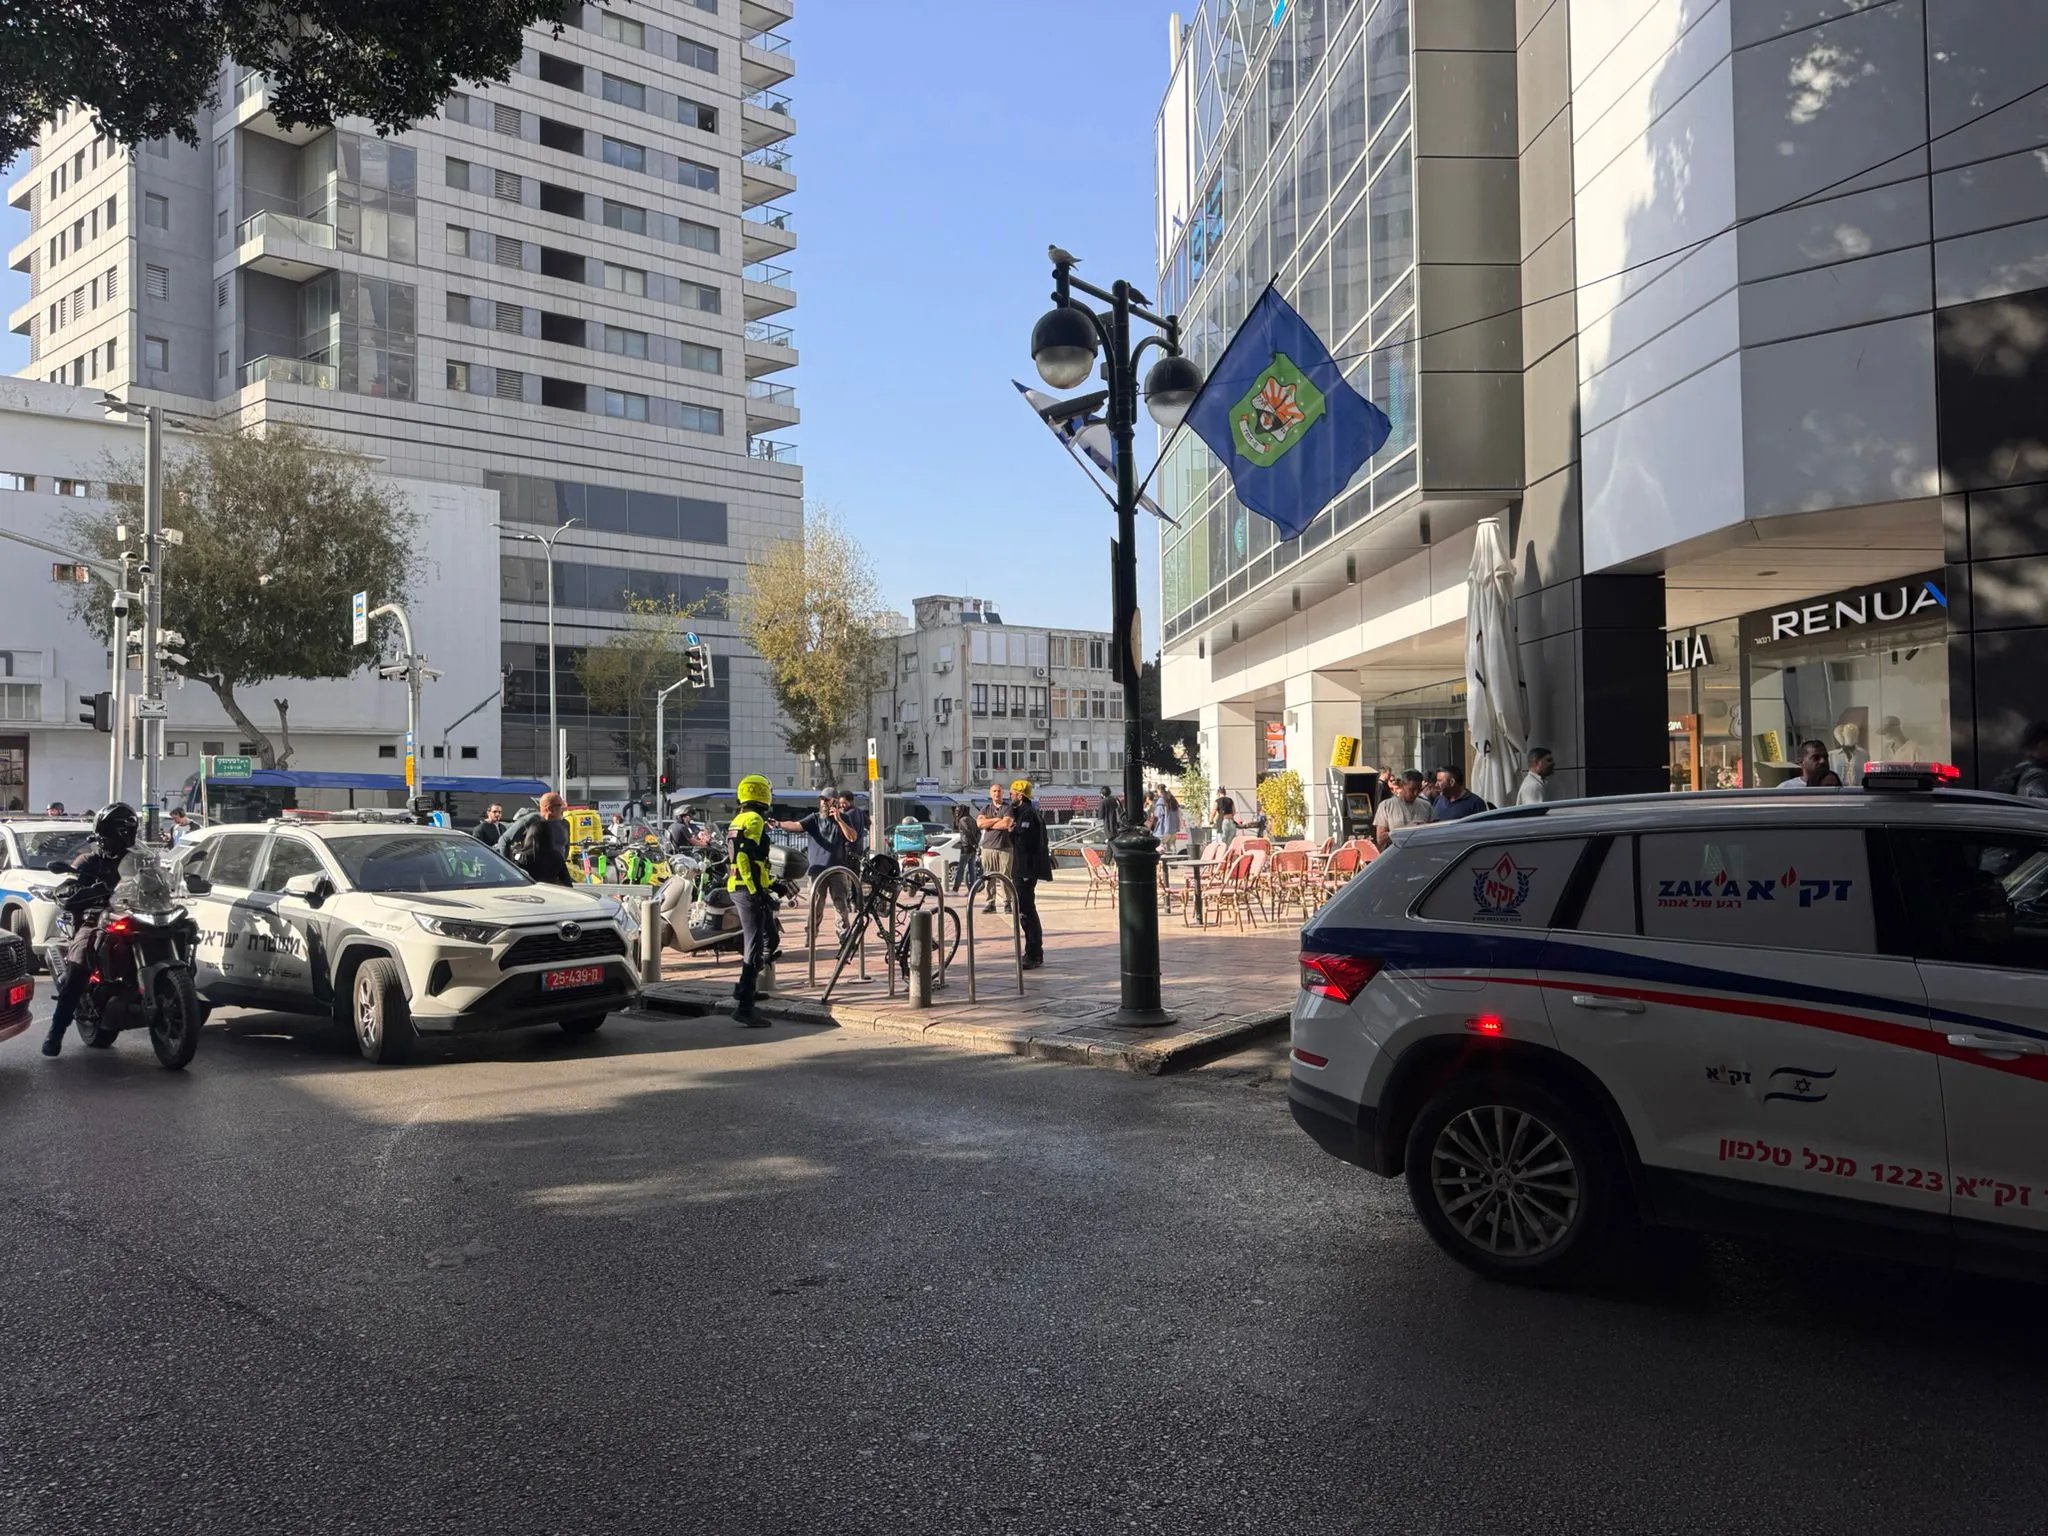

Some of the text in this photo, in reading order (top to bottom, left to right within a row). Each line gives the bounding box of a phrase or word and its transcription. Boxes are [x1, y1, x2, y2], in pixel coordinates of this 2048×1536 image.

[1771, 581, 1947, 641] RENUA
[1667, 634, 1708, 671] LIA
[1692, 898, 1712, 908] של
[1715, 899, 1742, 908] רגע
[1719, 1138, 1792, 1167] טלפון
[1802, 1147, 1857, 1177] מכל
[1870, 1163, 1944, 1192] 1223
